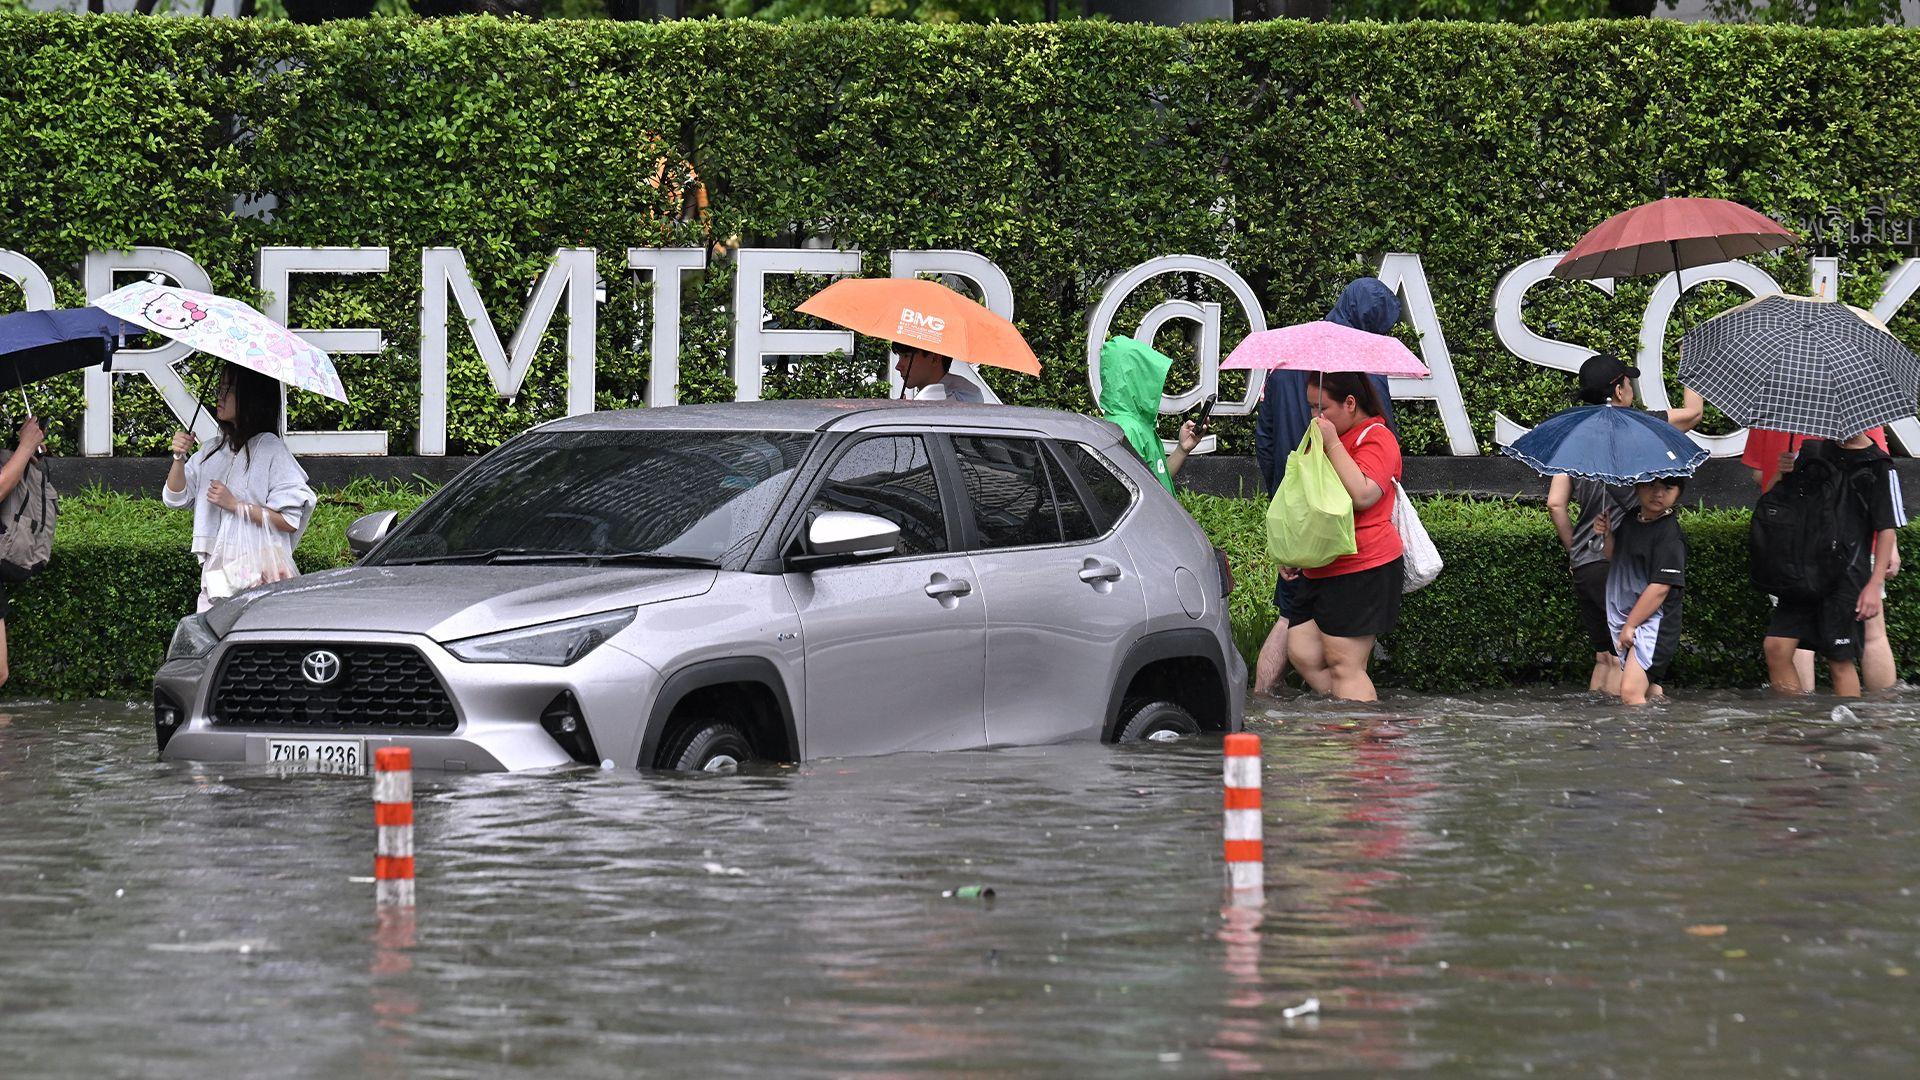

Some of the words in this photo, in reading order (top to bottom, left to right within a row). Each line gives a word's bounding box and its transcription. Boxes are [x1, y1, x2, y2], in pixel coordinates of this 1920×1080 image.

[901, 307, 945, 331] BMG
[0, 246, 1014, 457] REMIER
[1087, 254, 1267, 454] @
[316, 745, 357, 765] 1236
